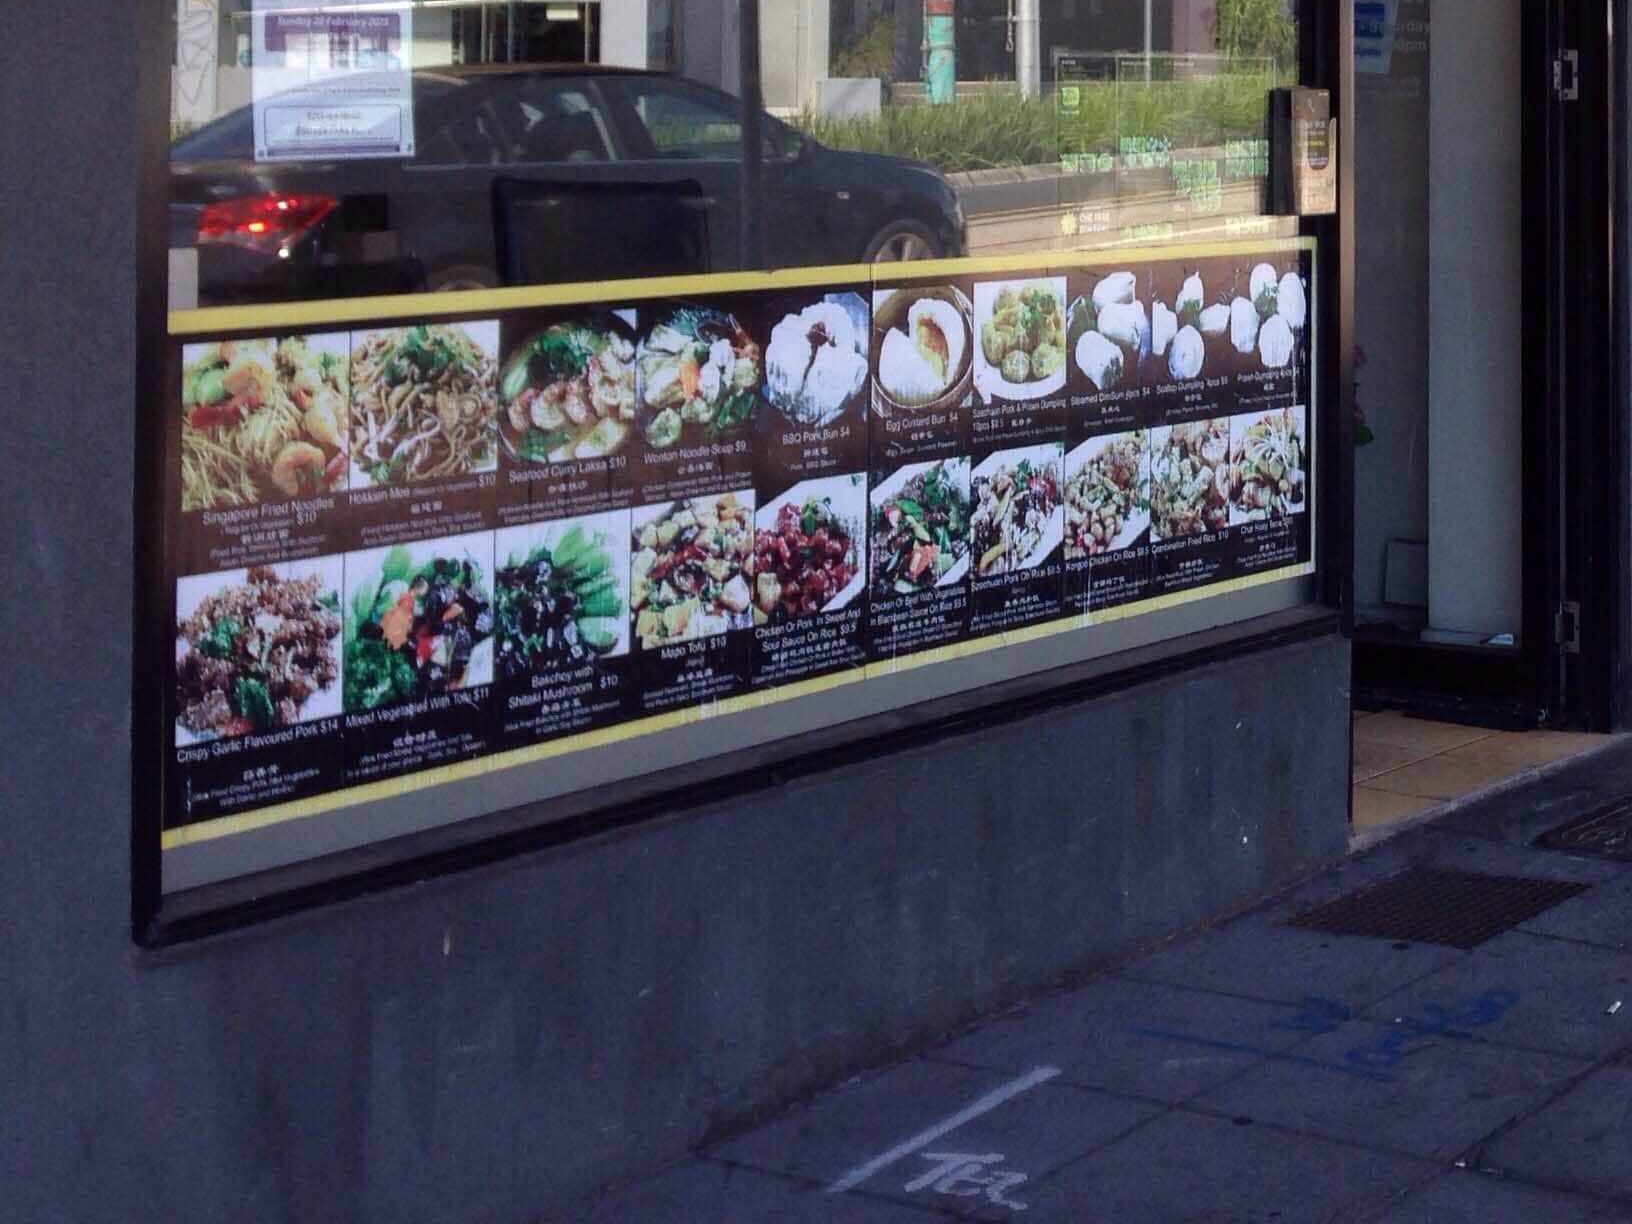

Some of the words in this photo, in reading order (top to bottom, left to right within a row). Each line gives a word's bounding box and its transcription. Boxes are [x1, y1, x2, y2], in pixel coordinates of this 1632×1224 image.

[931, 414, 946, 425] Bun
[710, 443, 734, 455] Soup
[508, 467, 550, 484] Seafood
[550, 463, 577, 476] Curry
[579, 460, 608, 473] Laksa
[608, 455, 627, 469] $10
[478, 473, 497, 488] $10
[202, 507, 258, 526] Singapore
[260, 502, 289, 518] Fried
[290, 496, 336, 514] Noodles
[296, 510, 318, 526] $10
[755, 624, 785, 639] Chicken
[785, 621, 795, 633] Or
[796, 619, 813, 630] Pork
[687, 640, 707, 654] Tofu
[761, 640, 780, 653] Sour
[782, 635, 806, 648] Sauce
[807, 631, 818, 642] On
[819, 628, 837, 639] Rice
[599, 674, 619, 689] $10
[543, 682, 593, 701] Mushroom
[345, 712, 375, 728] Mixed
[176, 748, 209, 764] Crispy
[212, 741, 242, 757] Garlic
[244, 730, 294, 749] Flavoured
[295, 727, 319, 740] Pork
[320, 719, 339, 735] $14
